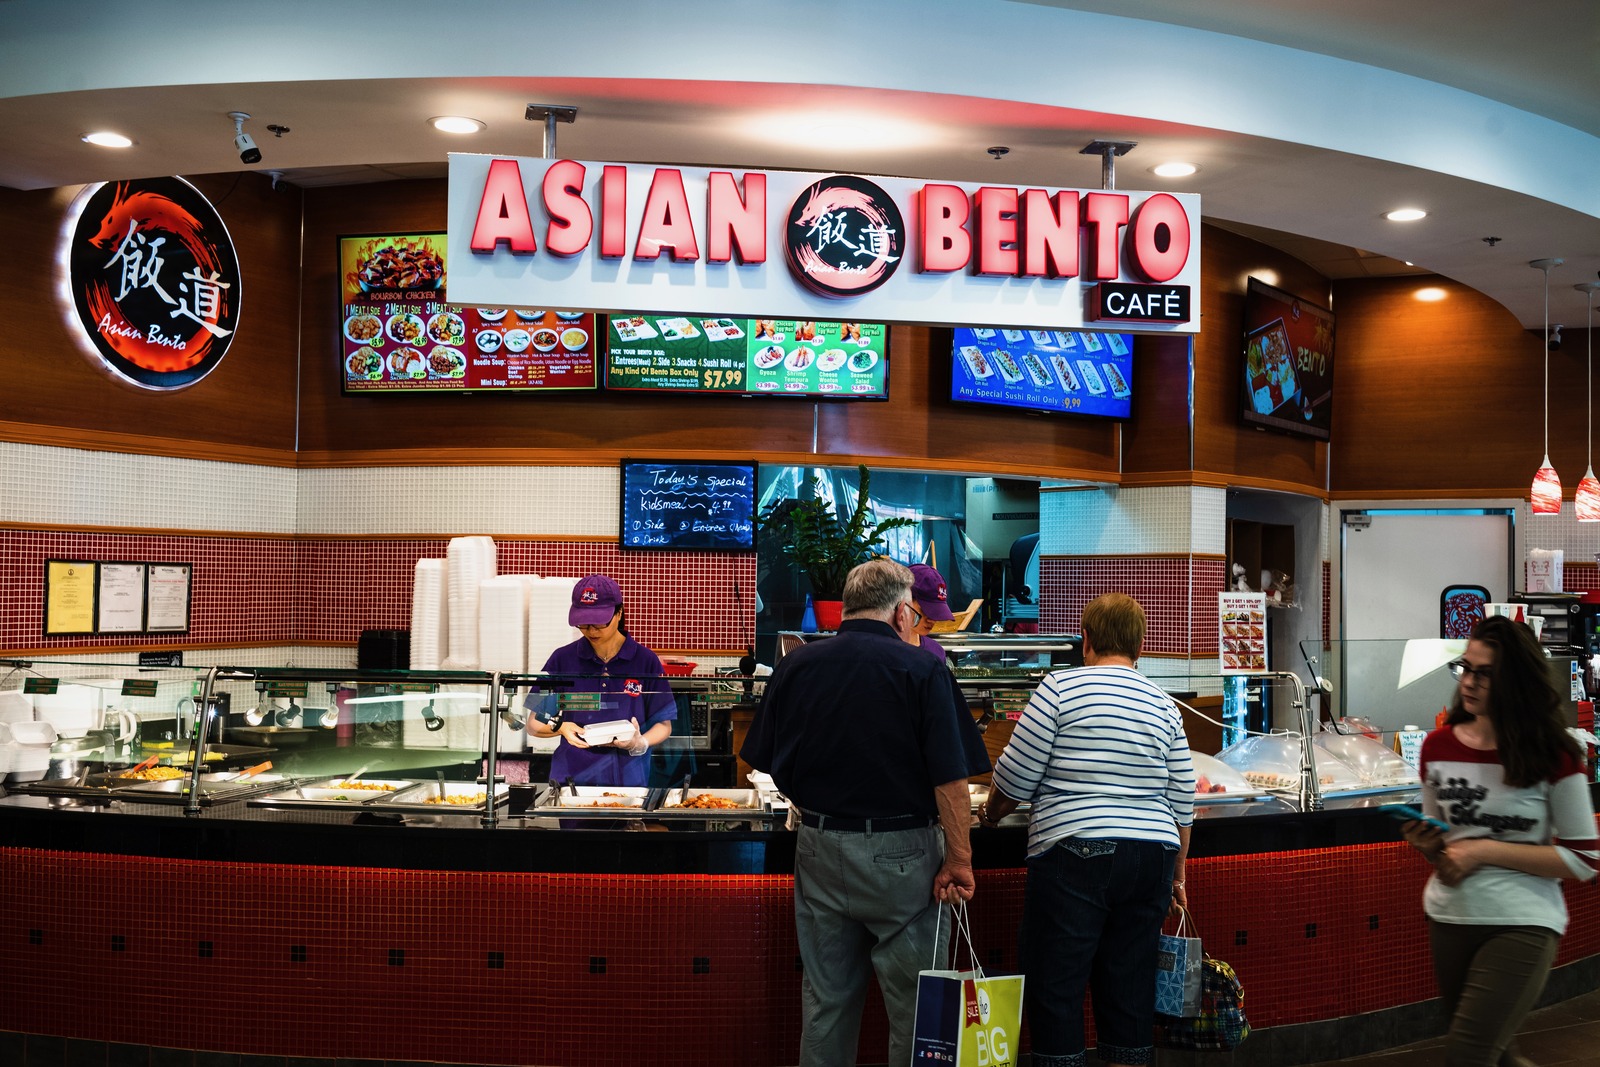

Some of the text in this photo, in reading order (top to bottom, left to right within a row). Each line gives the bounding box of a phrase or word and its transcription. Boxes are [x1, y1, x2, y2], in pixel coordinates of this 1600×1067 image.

[470, 159, 1191, 283] ASIAN BENTO
[371, 291, 435, 300] BOURBON CHICKEN
[386, 304, 390, 315] 2
[426, 302, 430, 314] 3
[1107, 291, 1180, 317] CAFÉ
[97, 312, 187, 350] Asian Bento
[720, 359, 732, 368] Roll
[1297, 347, 1326, 378] BENTO
[611, 367, 624, 376] Any
[670, 368, 682, 376] Box
[684, 368, 698, 378] Only
[704, 369, 742, 388] $7.99
[960, 386, 1081, 408] Any Special Sushi Roll Only $9.99
[650, 470, 746, 491] Today's Special
[643, 519, 666, 531] Side
[692, 519, 726, 532] Entree
[642, 535, 669, 545] Drink
[967, 1005, 979, 1018] SALE
[976, 1026, 1010, 1066] BIG
